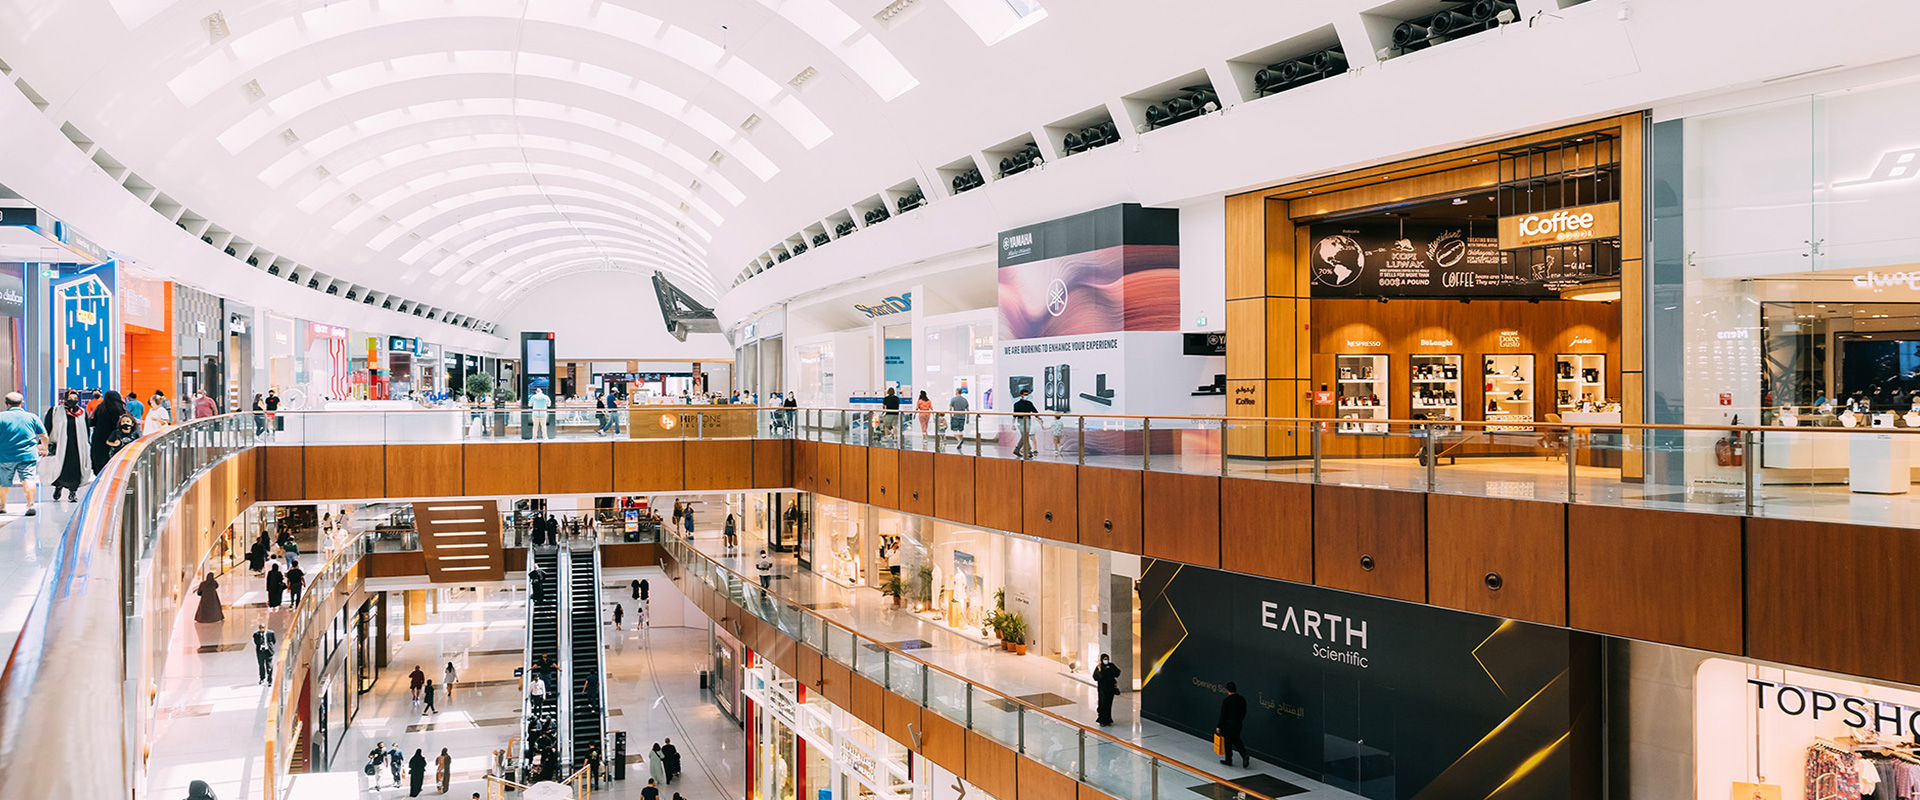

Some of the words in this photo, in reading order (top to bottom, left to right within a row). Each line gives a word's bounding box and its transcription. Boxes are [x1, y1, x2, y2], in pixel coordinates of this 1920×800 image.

[1519, 211, 1594, 237] iCoffee
[1010, 232, 1033, 249] YAMAHA
[1386, 260, 1425, 268] LUWAK
[1391, 252, 1417, 260] KOPI
[1442, 271, 1475, 288] COFFEE
[1004, 346, 1011, 355] WE
[1011, 345, 1020, 354] ARE
[1020, 344, 1041, 354] WORKING
[1042, 343, 1048, 352] TO
[1048, 342, 1071, 353] ENHANCE
[1071, 341, 1085, 351] YOUR
[1086, 339, 1118, 350] EXPERIENCE
[1499, 335, 1520, 343] Dolce
[1568, 336, 1592, 347] jura
[1235, 397, 1256, 405] iCoffee
[1262, 600, 1367, 650] EARTH
[1312, 643, 1369, 668] Scientific
[1191, 676, 1217, 693] Opening
